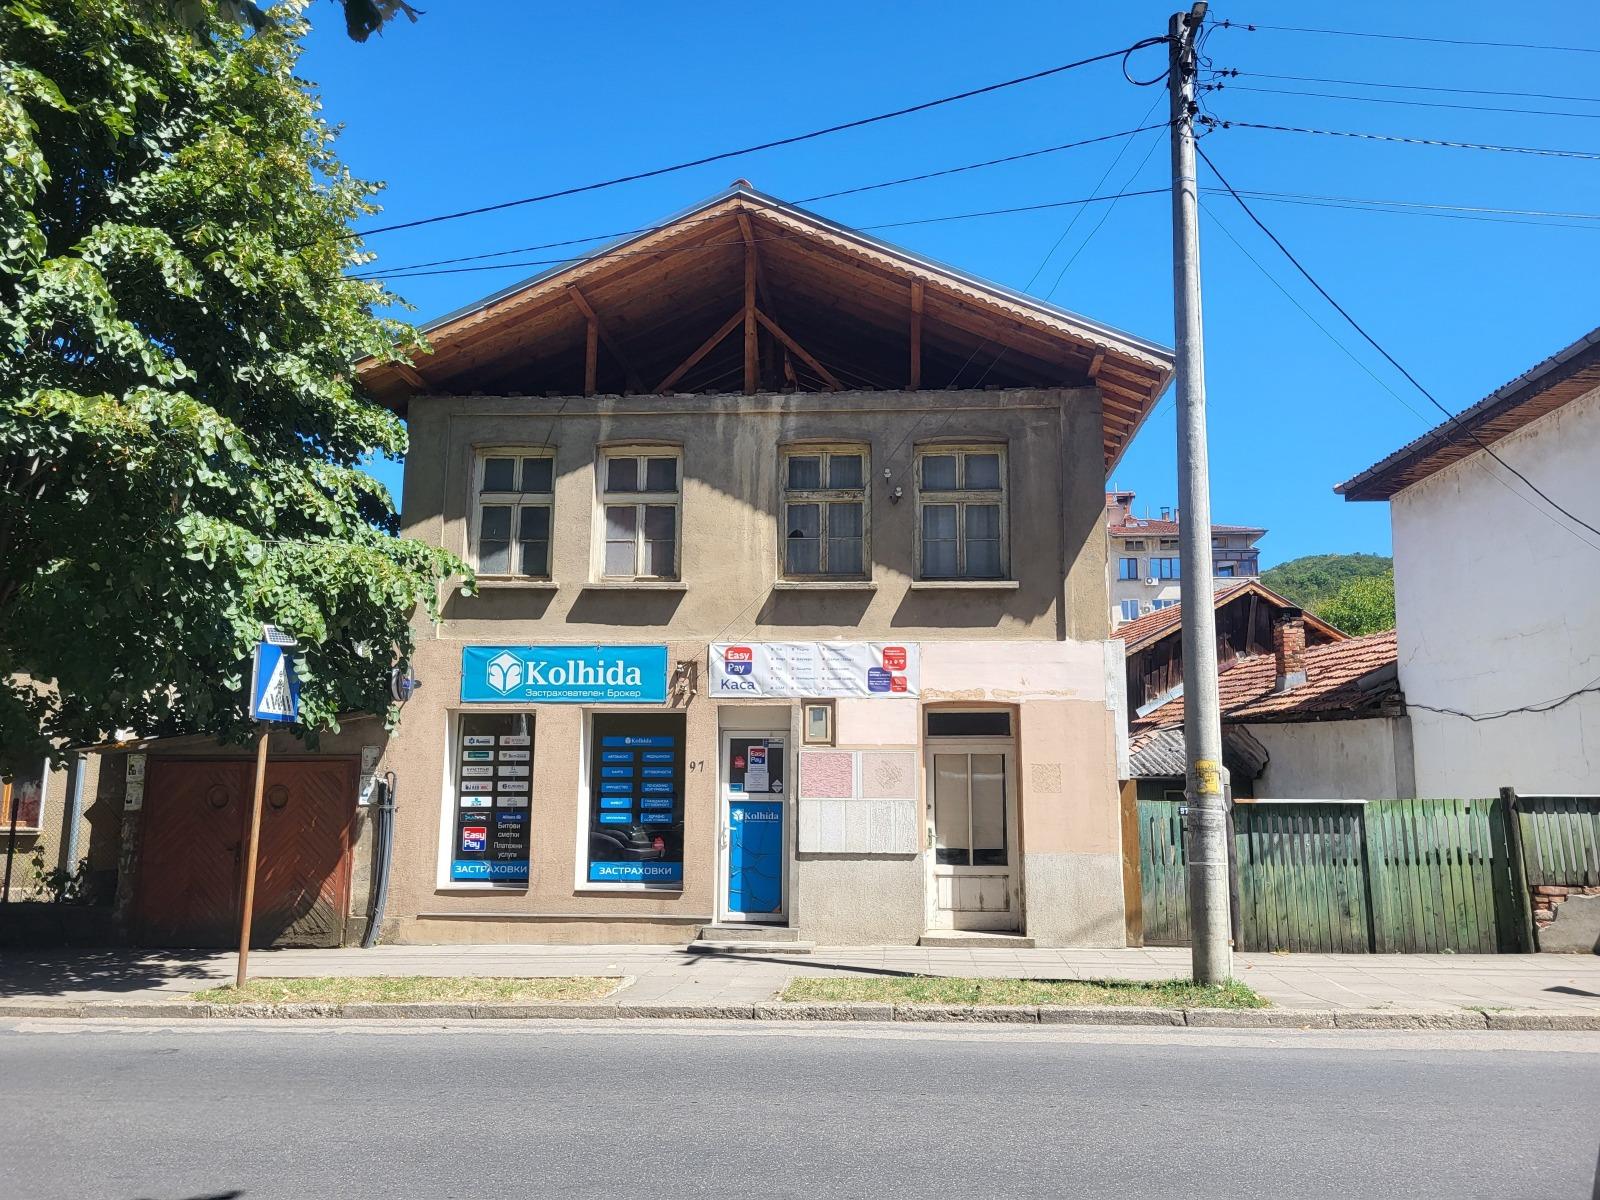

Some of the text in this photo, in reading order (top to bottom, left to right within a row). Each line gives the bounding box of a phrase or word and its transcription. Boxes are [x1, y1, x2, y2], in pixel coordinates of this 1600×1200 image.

[727, 650, 750, 661] Easy
[728, 663, 745, 673] Pay
[525, 660, 642, 686] Kolhida
[720, 679, 756, 690] Каса
[525, 688, 641, 697] Застрахователен Брокер
[689, 760, 704, 773] 97
[744, 812, 779, 820] Kolhida
[497, 821, 521, 829] Битови
[464, 831, 485, 840] Easy
[464, 840, 480, 849] Pay
[454, 865, 528, 873] ЗАСТРАХОВКИ
[599, 867, 672, 875] ЗАСТРАХОВКИ
